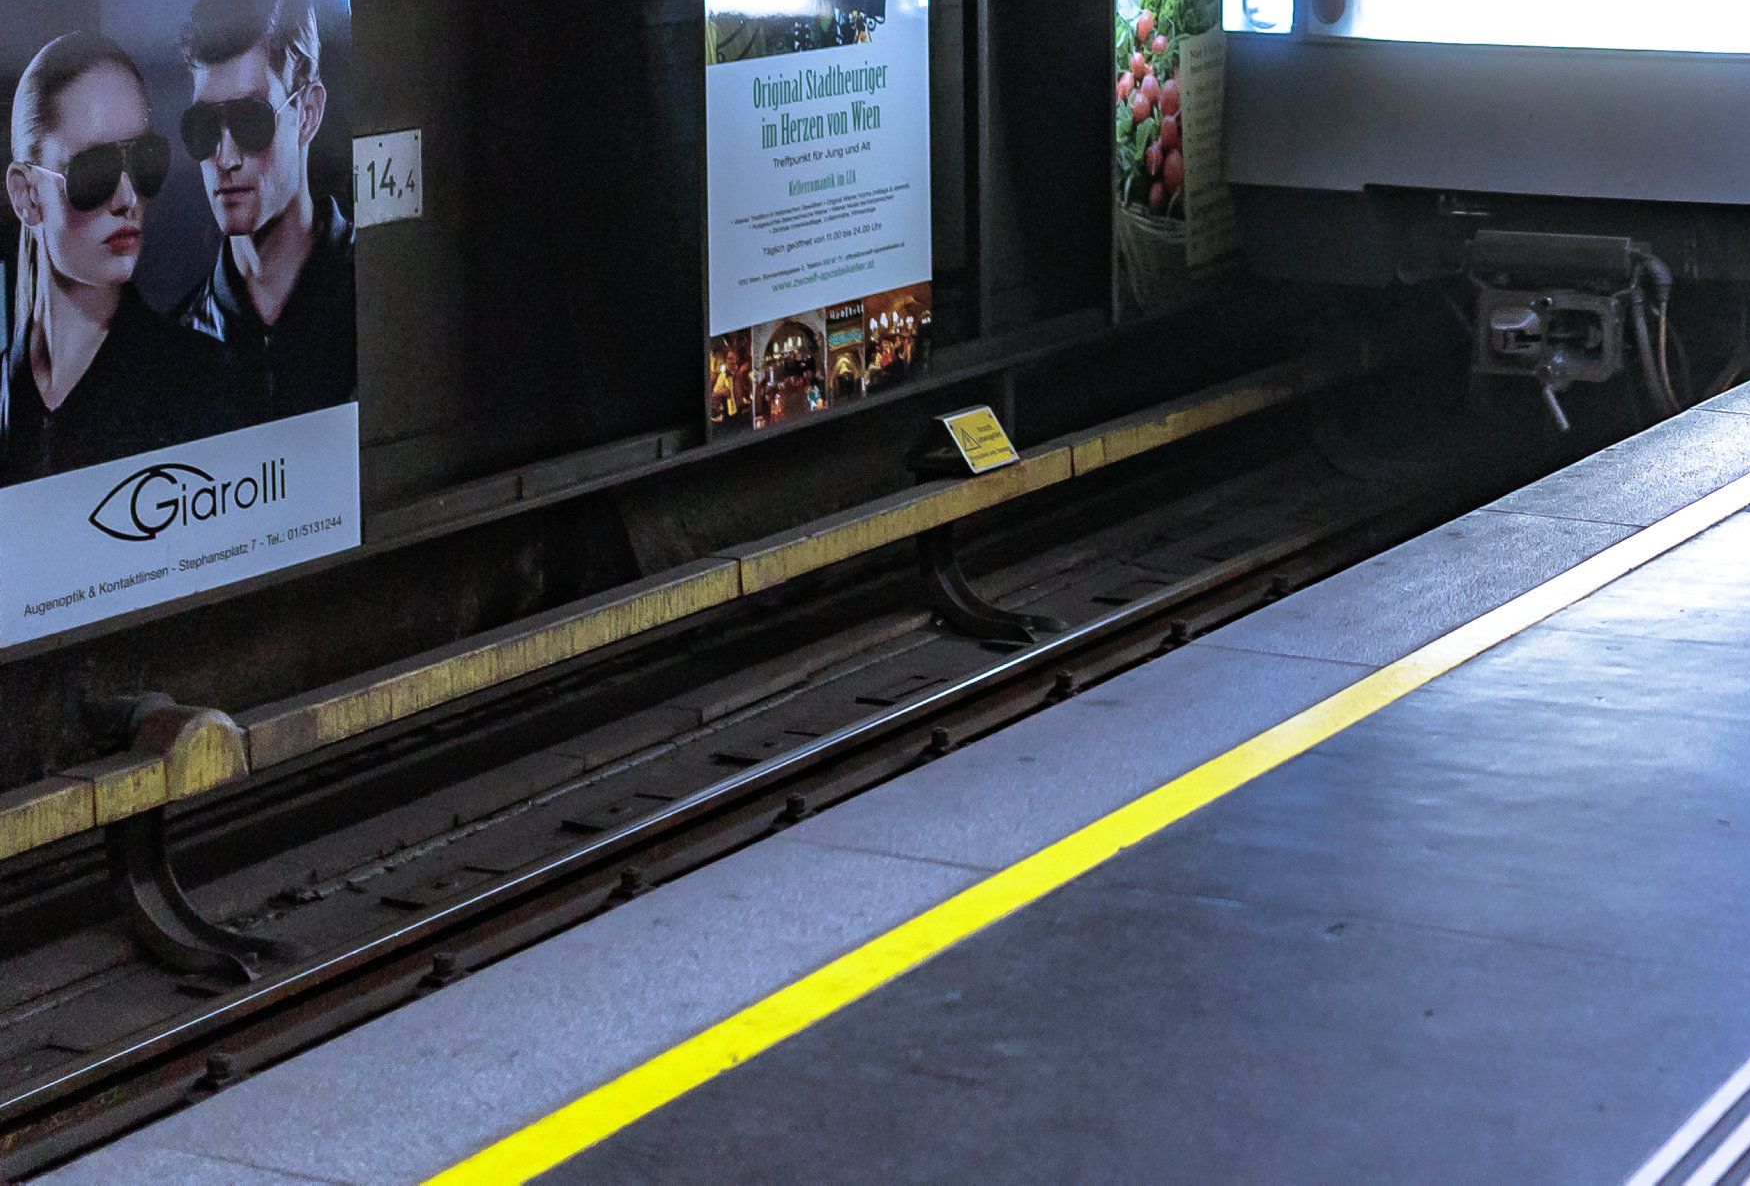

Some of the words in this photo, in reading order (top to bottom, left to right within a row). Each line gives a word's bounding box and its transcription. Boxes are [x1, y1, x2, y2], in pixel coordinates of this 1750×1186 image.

[753, 70, 803, 111] Original
[806, 61, 888, 101] Stadtheuriger
[761, 118, 778, 149] im
[781, 112, 824, 145] Herzen
[827, 110, 848, 138] von
[851, 100, 881, 132] Wien
[772, 149, 811, 169] Treffpunkt
[813, 149, 823, 160] für
[824, 147, 844, 160] Jung
[846, 142, 859, 155] und
[861, 140, 871, 152] Alt
[131, 458, 286, 534] Giarolli
[23, 589, 86, 617] Augenoptik
[88, 585, 97, 599] &
[98, 566, 169, 595] Kontaktlinsen
[178, 544, 248, 572] Stephansplatz
[250, 539, 257, 552] 7
[287, 515, 343, 542] 01/5131244
